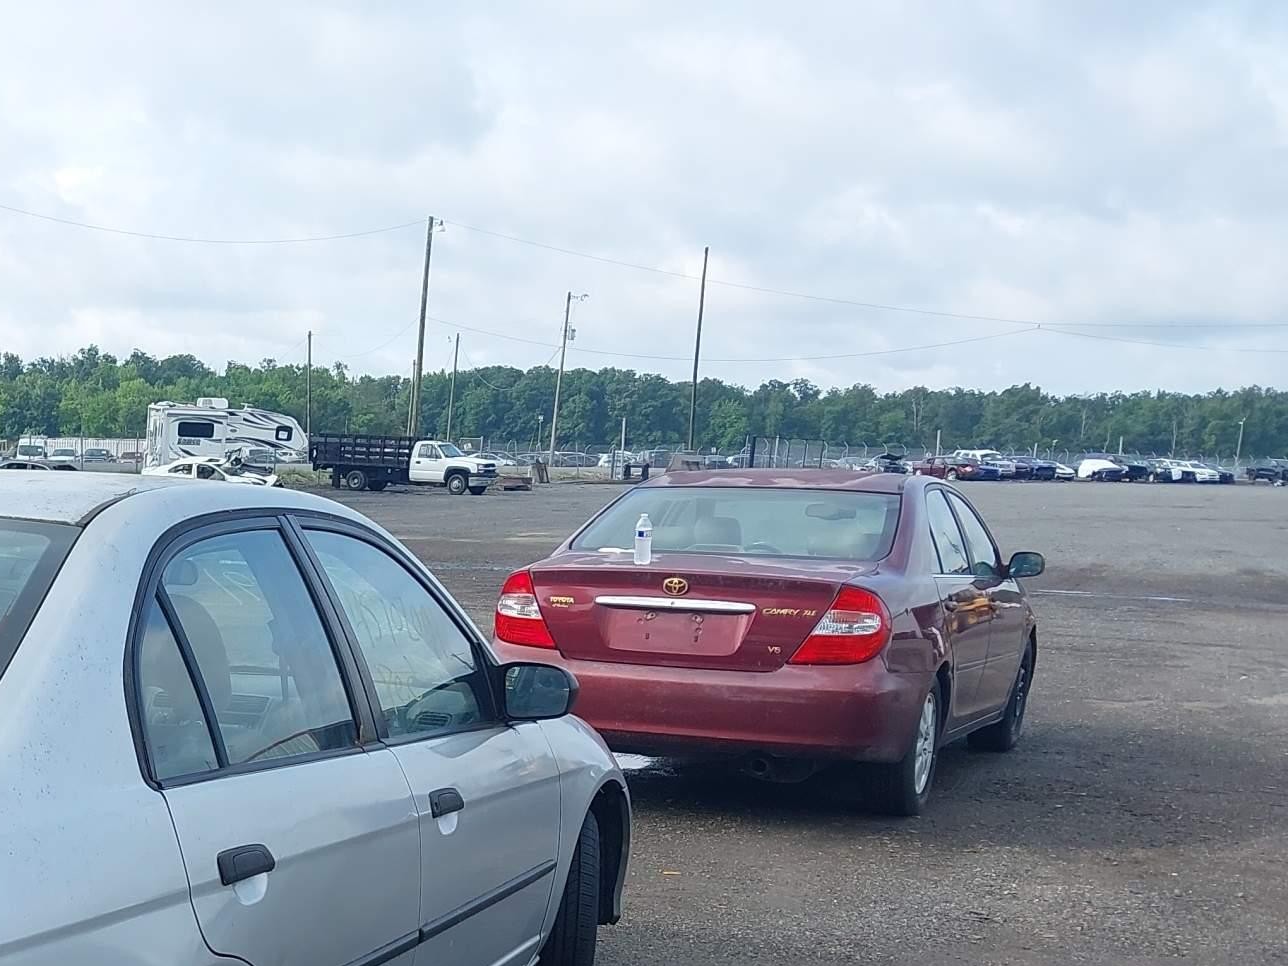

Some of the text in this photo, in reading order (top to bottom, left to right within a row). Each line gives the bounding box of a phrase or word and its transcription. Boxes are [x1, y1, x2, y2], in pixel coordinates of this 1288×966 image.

[550, 596, 575, 604] TOYOTA
[762, 608, 800, 617] CAMRY
[767, 645, 782, 654] V6
